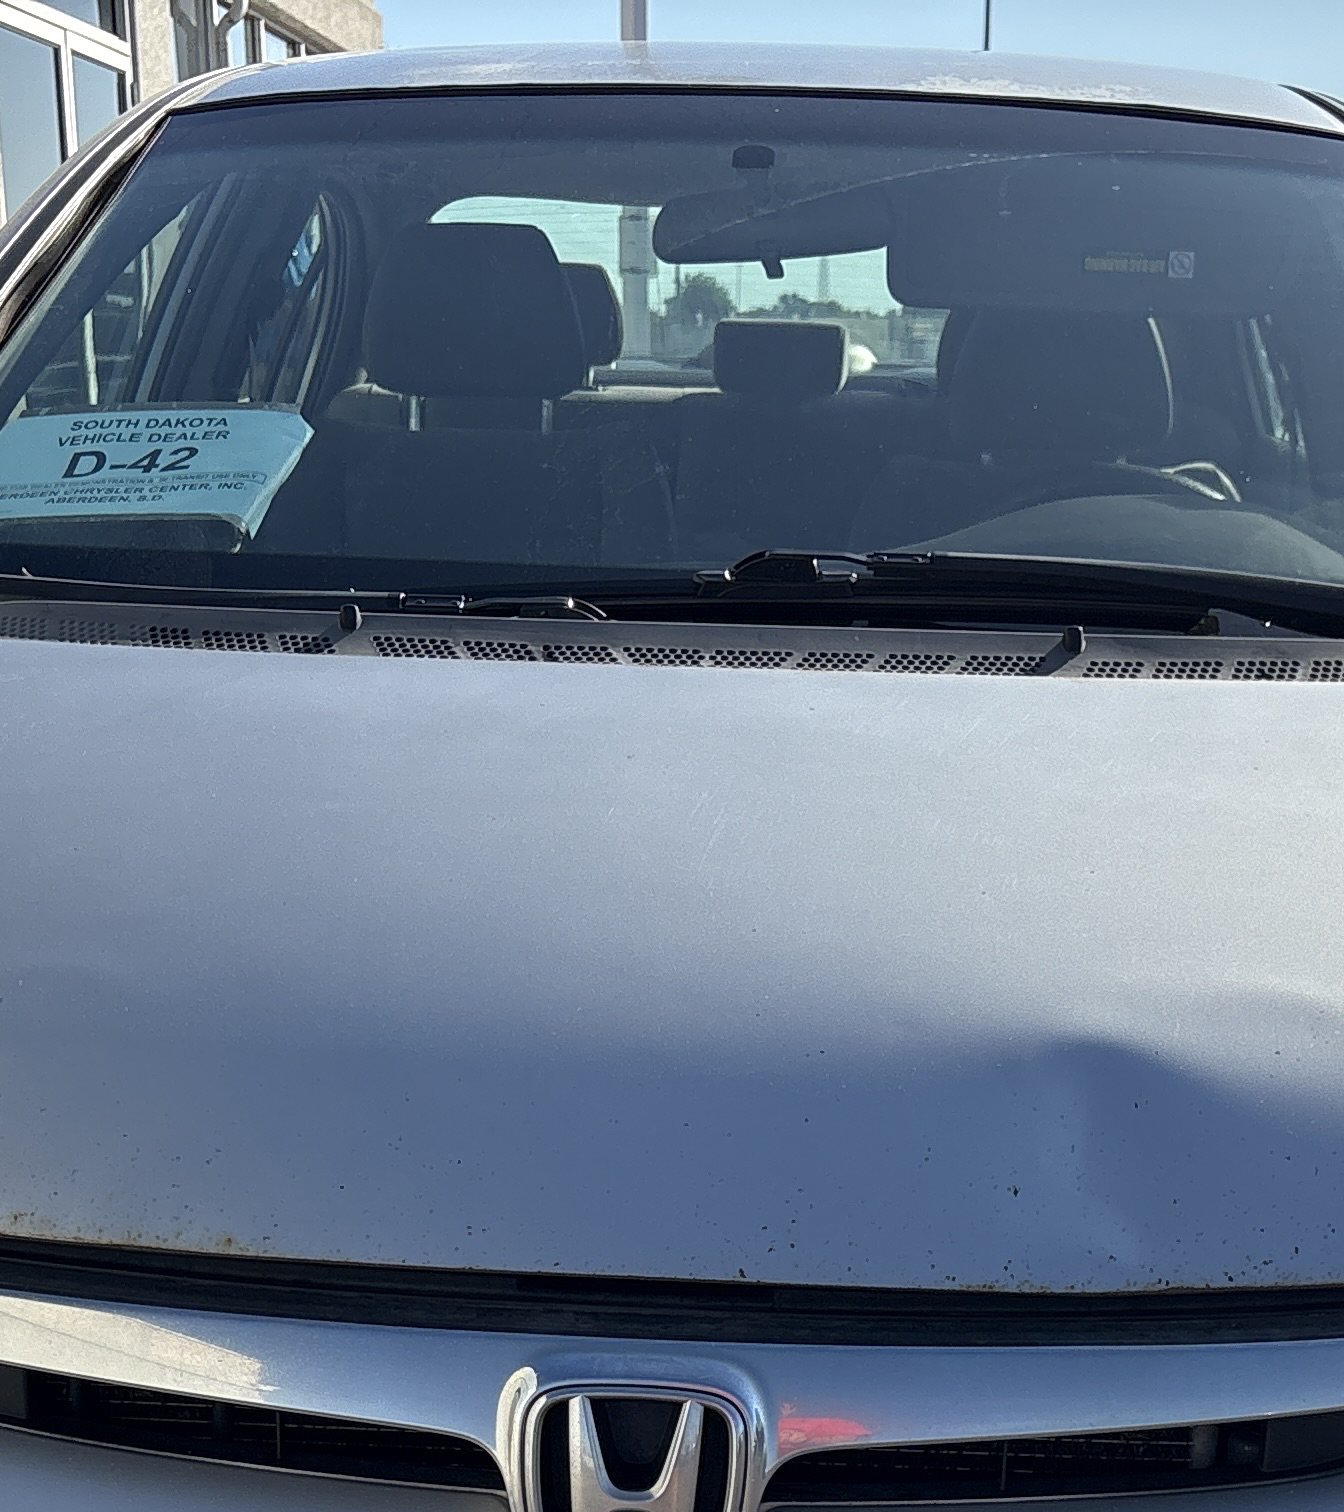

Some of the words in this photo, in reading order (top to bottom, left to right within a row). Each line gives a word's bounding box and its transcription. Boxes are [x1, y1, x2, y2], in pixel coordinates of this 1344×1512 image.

[70, 418, 140, 431] SOUTH
[145, 417, 228, 429] DAKOTA
[58, 432, 142, 447] VEHICLE
[147, 430, 230, 443] DEALER
[62, 446, 199, 479] D-42
[63, 487, 144, 496] CHRYSLER
